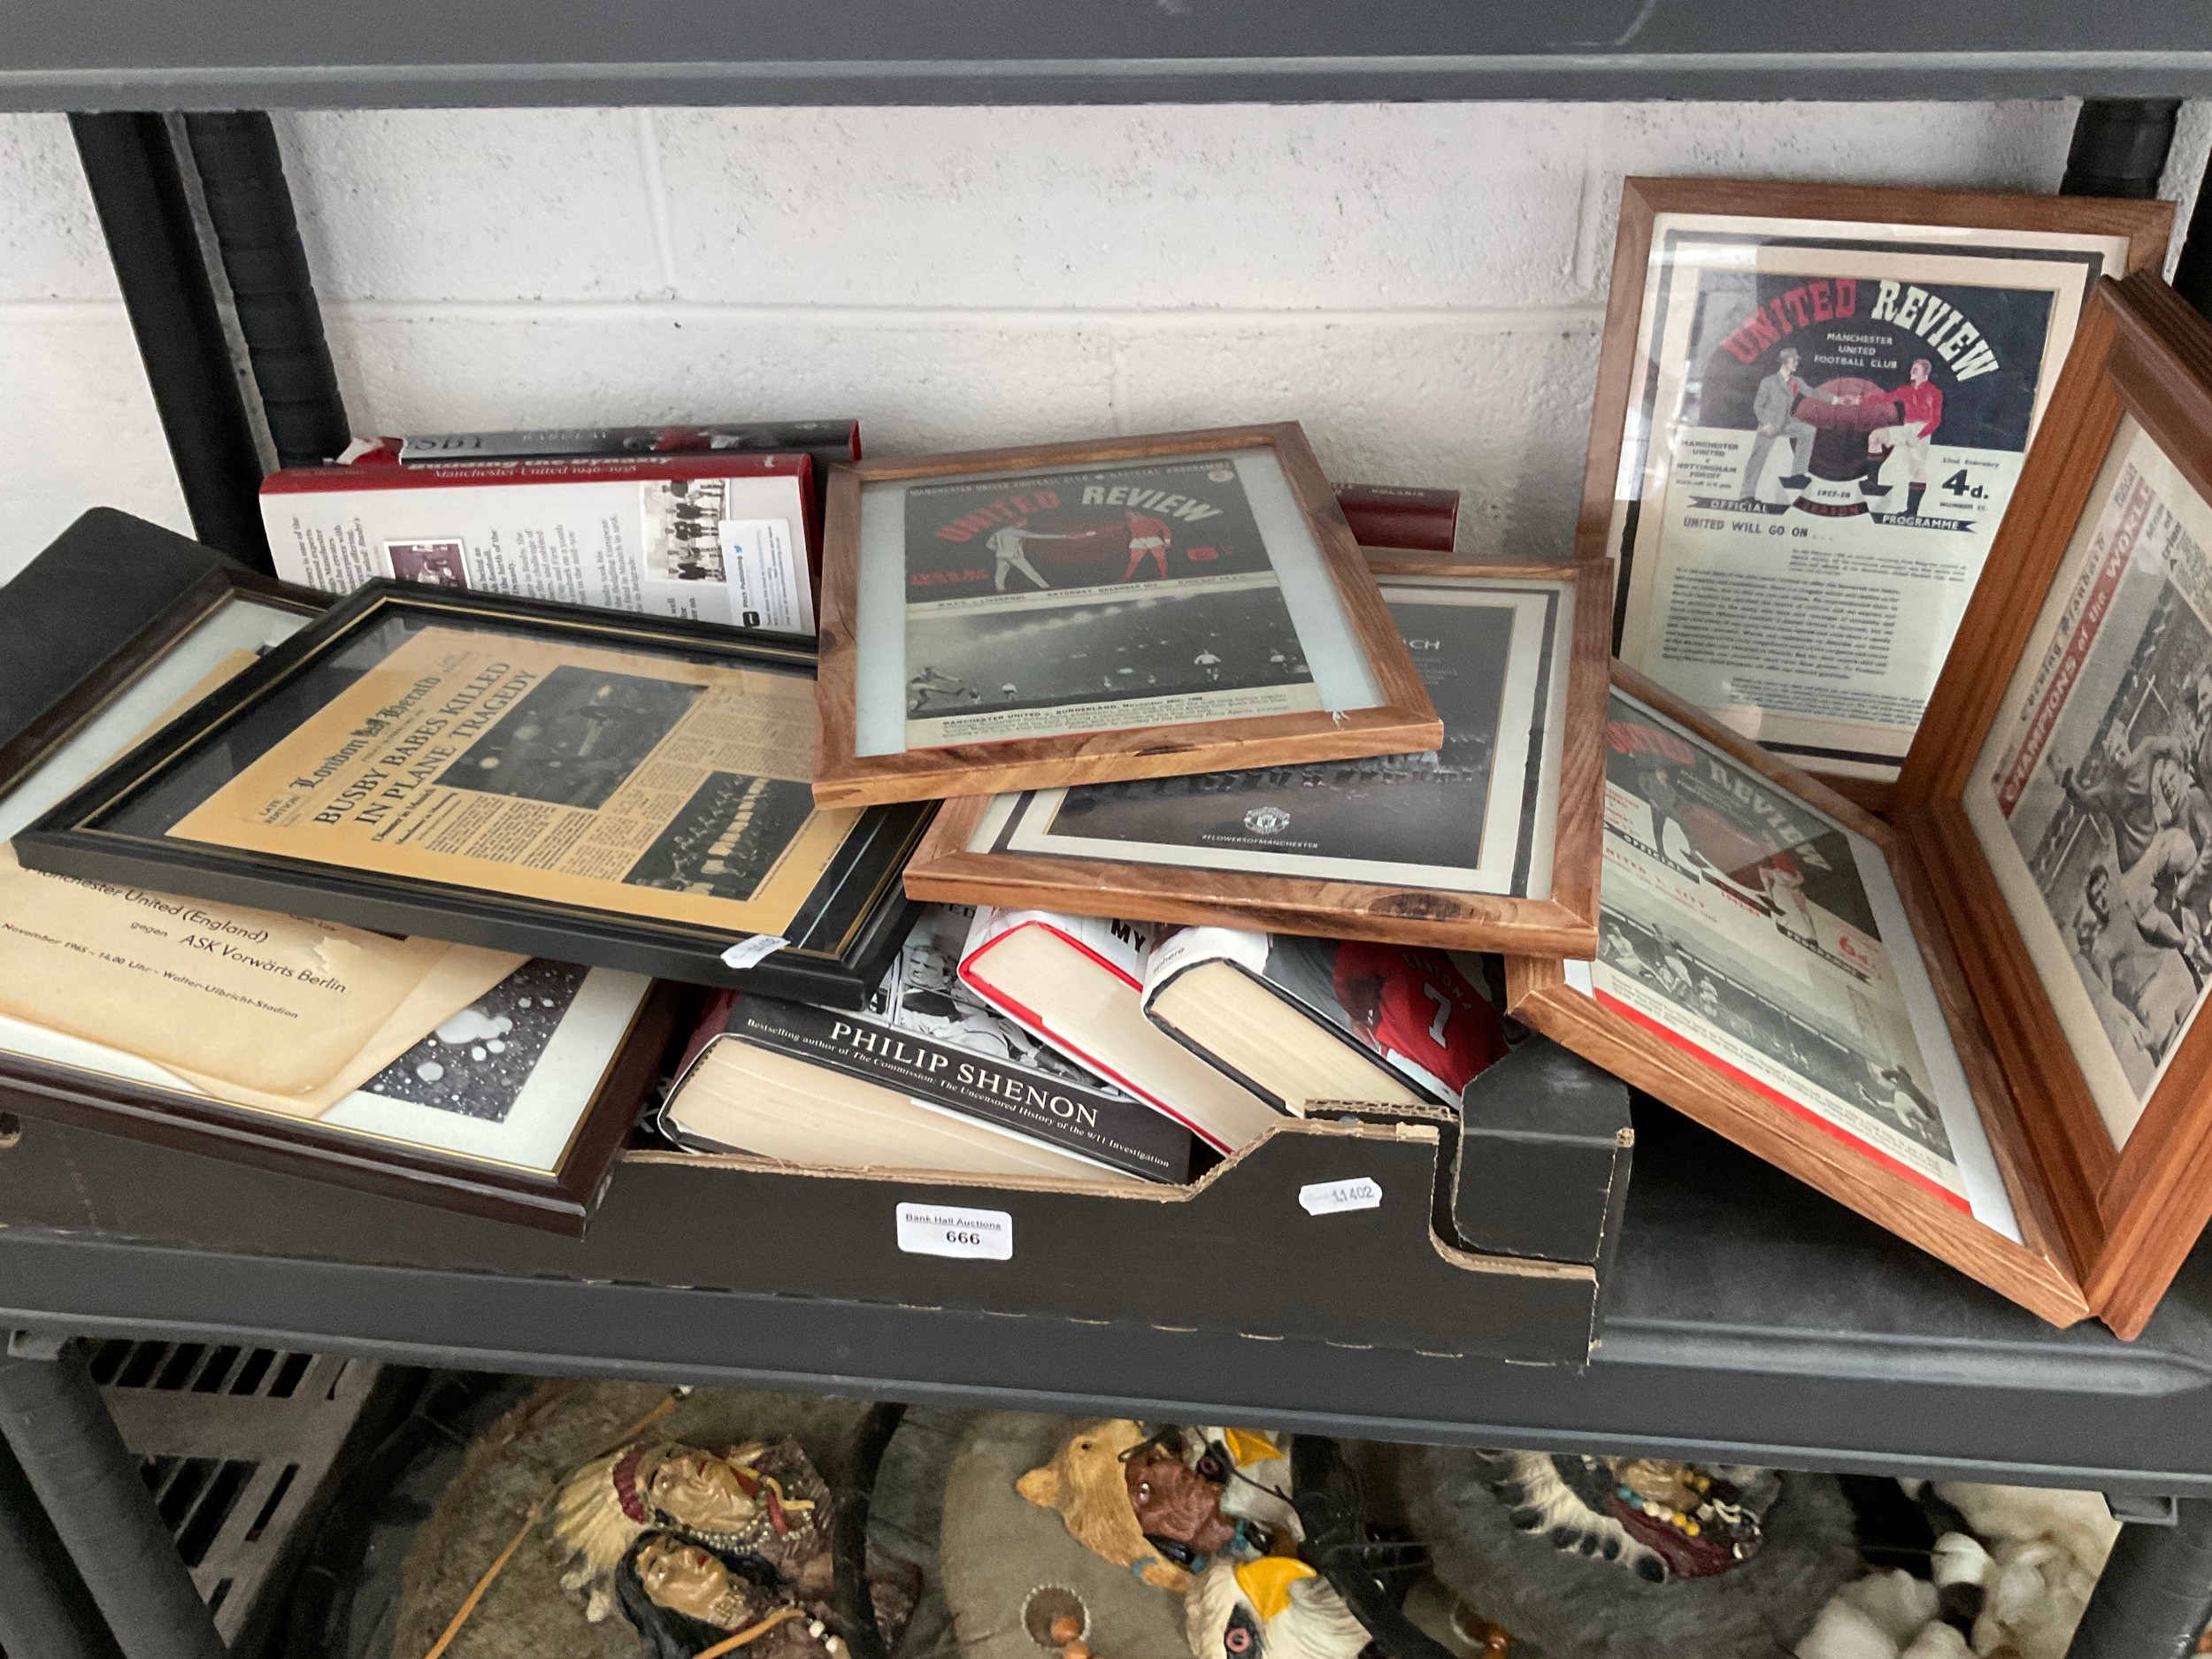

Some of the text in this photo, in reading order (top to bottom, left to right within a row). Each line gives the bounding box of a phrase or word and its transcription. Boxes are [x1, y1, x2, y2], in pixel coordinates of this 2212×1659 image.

[1720, 278, 2000, 381] UNITED REVIEW
[1826, 333, 1893, 345] MANCHESTER
[1814, 355, 1898, 369] FOOTBALL CLUB
[1838, 345, 1876, 356] UNITED
[1681, 440, 1739, 450] MANCHESTER
[1677, 463, 1737, 473] NOTTINGHAM
[1941, 469, 1989, 499] 4d.
[1081, 487, 1224, 522] REVIEW
[1710, 500, 1768, 514] OFFICIAL
[1683, 517, 1808, 537] UNITED WILL GO ON
[1882, 513, 1959, 530] PROGRAMME
[736, 556, 746, 589] Publishing
[2005, 654, 2078, 802] CHAMPIONS
[2078, 627, 2089, 651] of
[2088, 591, 2107, 624] the
[289, 675, 442, 789] London Herald
[942, 715, 1004, 726] MANCHESTER
[312, 768, 389, 825] BUSBY
[380, 718, 448, 767] BABES
[439, 663, 511, 715] KILLED
[353, 802, 392, 825] IN
[380, 745, 457, 800] PLANE
[450, 669, 539, 740] TRAGEDY
[257, 797, 283, 816] LATE
[1709, 758, 1832, 872] REVIEW
[1202, 834, 1318, 849] #FLOWERSOFMANCHESTER
[125, 888, 184, 917] United
[182, 908, 269, 944] (England)
[1110, 918, 1147, 953] MY
[2, 922, 62, 945] November
[128, 960, 152, 973] Uhr
[164, 970, 298, 1019] Walter-Ulbricht-Stadion
[130, 921, 346, 994] gegen ASK Vorwärts Berlin
[1153, 947, 1186, 972] sphere
[1424, 980, 1452, 1049] 7
[829, 1020, 1100, 1128] PHILIP SHENON
[747, 1018, 1170, 1168] Bestselling author of The Commission: The Uncensored History of the 9/11 Investigation
[906, 1213, 1002, 1230] Bank Hall Auctions
[946, 1231, 980, 1245] 666
